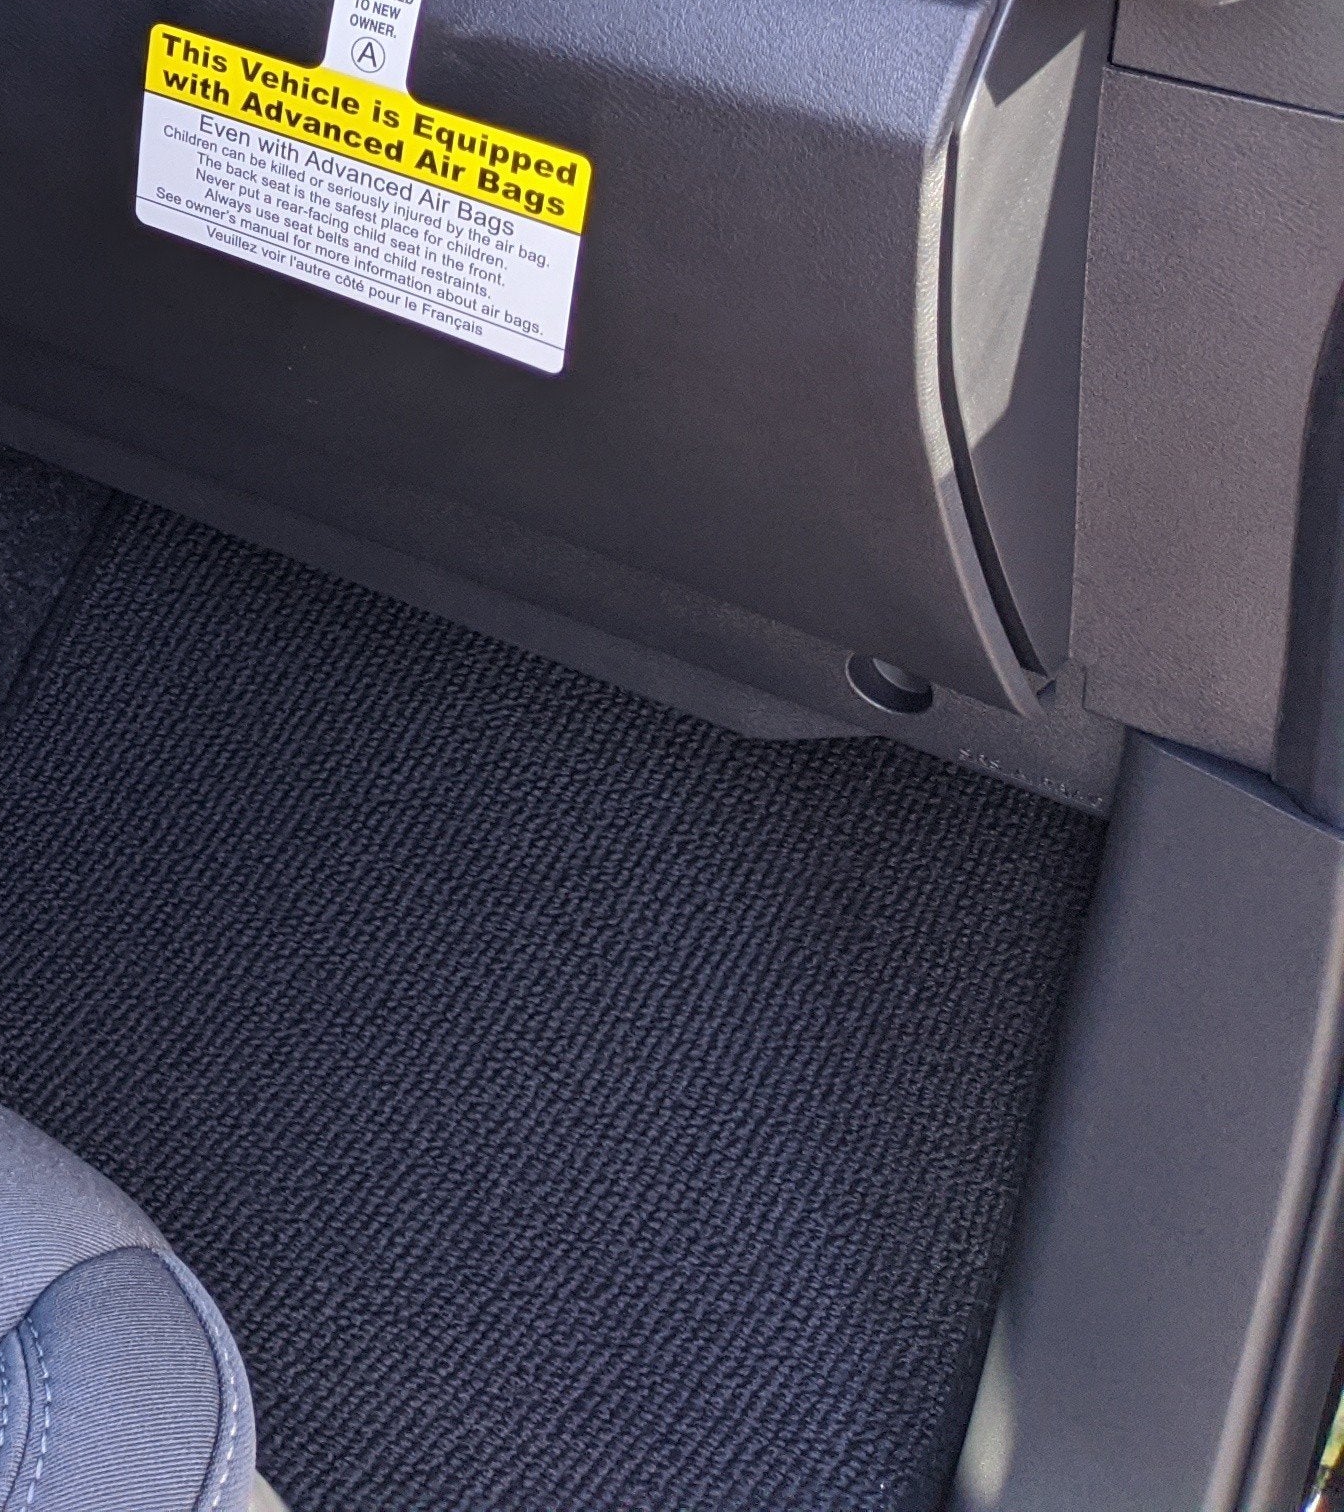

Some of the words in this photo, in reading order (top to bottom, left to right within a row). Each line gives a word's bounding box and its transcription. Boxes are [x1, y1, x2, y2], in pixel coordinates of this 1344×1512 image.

[349, 14, 397, 38] OWNER.
[372, 1, 401, 20] NEW
[162, 32, 228, 73] This
[241, 57, 360, 115] Vehicle
[372, 99, 400, 129] is
[413, 113, 577, 186] Equipped
[163, 69, 230, 106] with
[240, 91, 404, 163] Advanced
[414, 148, 466, 182] Air
[477, 167, 565, 216] Bags
[163, 124, 218, 153] Children
[221, 146, 246, 163] can
[249, 152, 267, 170] be
[270, 159, 306, 183] killed
[309, 176, 324, 188] or
[327, 182, 390, 214] seriously
[393, 201, 442, 230] injured
[446, 220, 464, 239] by
[468, 228, 491, 246] the
[495, 240, 515, 254] air
[518, 244, 550, 268] bag.
[195, 167, 236, 192] Never
[238, 184, 260, 201] put
[263, 194, 272, 205] a
[276, 197, 349, 234] rear-facing
[353, 224, 386, 245] child
[390, 238, 421, 257] seat
[424, 246, 437, 263] in
[442, 253, 464, 272] the
[469, 262, 505, 287] front.
[196, 151, 222, 171] The
[226, 161, 258, 184] back
[261, 176, 291, 195] seat
[294, 184, 305, 200] is
[309, 190, 331, 208] the
[334, 201, 377, 225] safest
[380, 217, 419, 239] place
[423, 229, 444, 247] for
[446, 240, 507, 270] children.
[199, 113, 251, 148] Even
[258, 137, 299, 164] with
[304, 150, 413, 202] Advanced
[417, 188, 451, 214] Air
[457, 200, 514, 236] Bags
[155, 186, 182, 205] See
[185, 199, 236, 225] owner's
[240, 218, 289, 243] manual
[293, 234, 312, 251] for
[314, 244, 350, 265] more
[354, 256, 432, 295] information
[436, 288, 477, 312] about
[481, 304, 501, 318] air
[504, 310, 543, 336] bags.
[204, 187, 252, 214] Always
[255, 207, 280, 224] use
[283, 217, 313, 236] seat
[316, 225, 350, 248] belts
[353, 242, 380, 259] and
[383, 252, 417, 272] child
[420, 265, 491, 299] restraints.
[206, 224, 258, 254] Veuillez
[261, 247, 287, 264] voir
[289, 254, 331, 280] l'autre
[334, 274, 365, 293] côté
[368, 286, 401, 305] pour
[404, 296, 417, 312] le
[421, 302, 483, 336] Français
